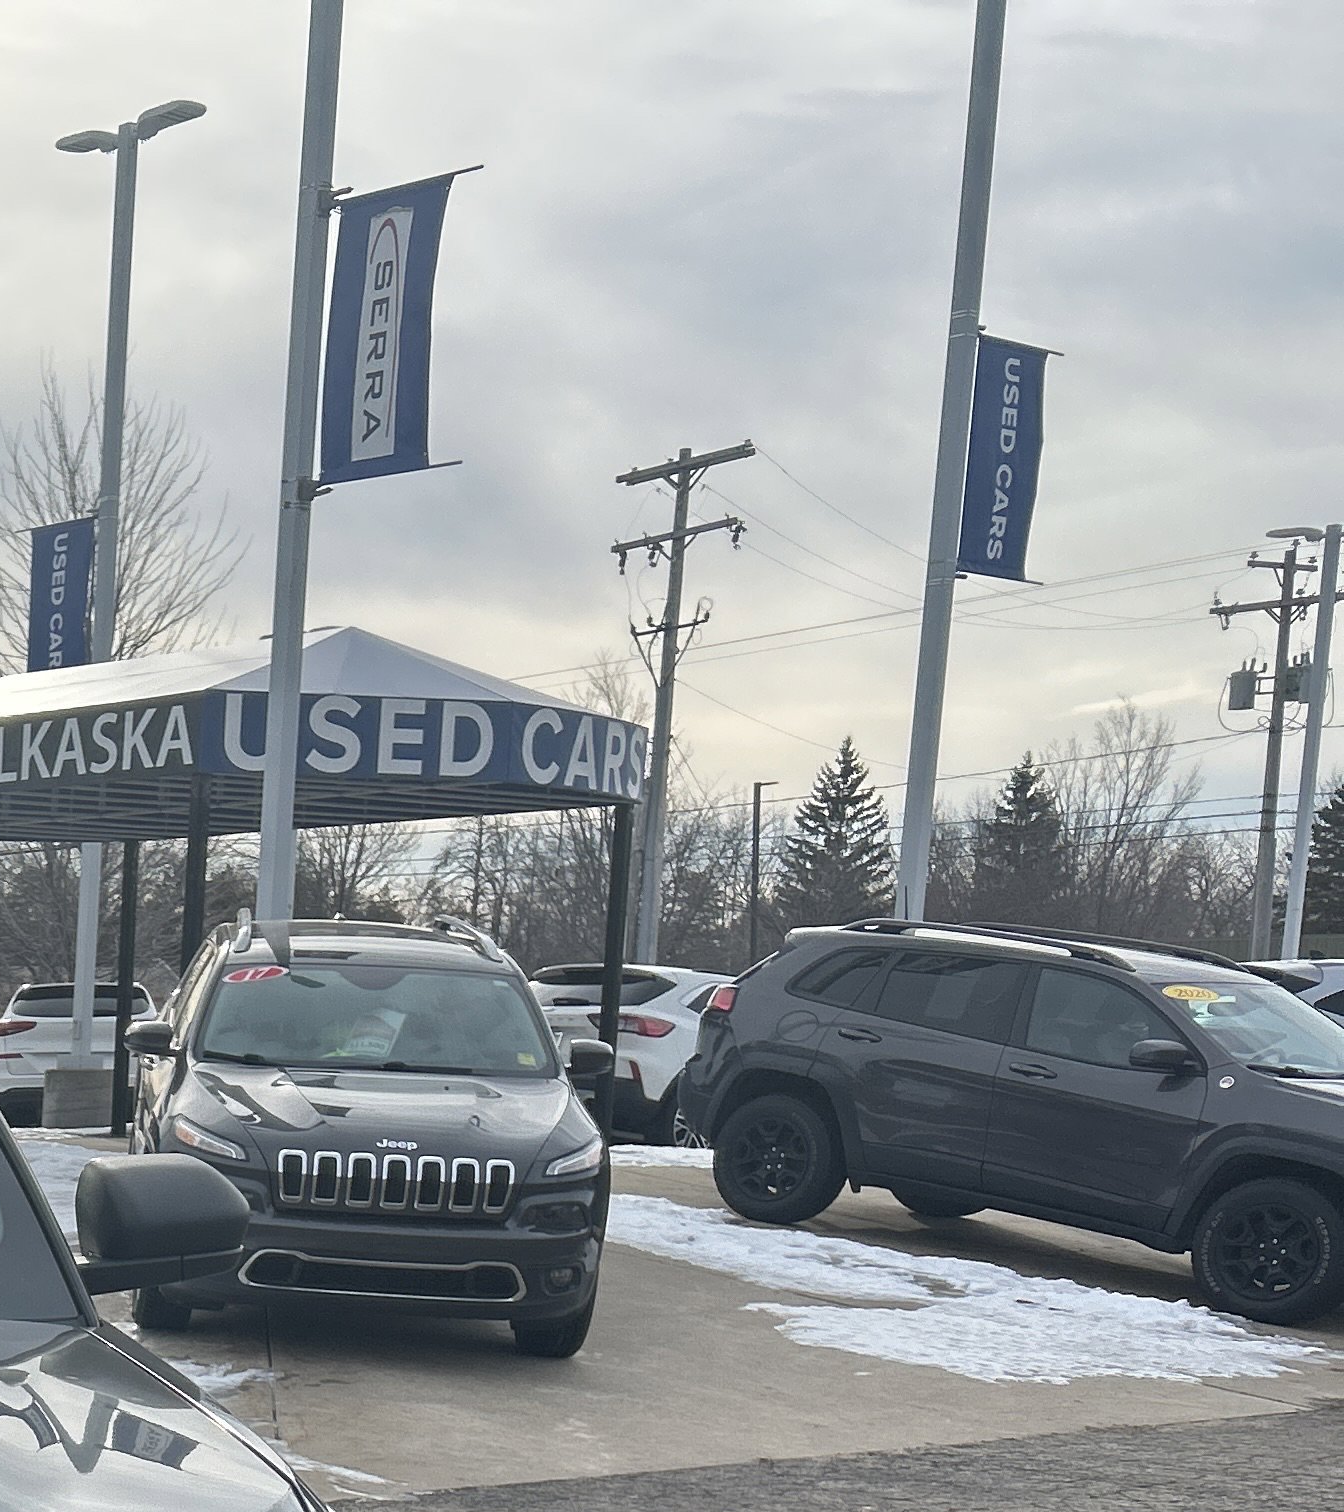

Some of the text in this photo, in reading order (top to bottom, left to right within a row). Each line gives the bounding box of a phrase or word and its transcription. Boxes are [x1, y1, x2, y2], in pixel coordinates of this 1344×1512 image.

[361, 260, 394, 443] SERRA
[986, 357, 1021, 560] USED CARS
[49, 532, 69, 668] USED CAR
[223, 692, 647, 800] USED CARS
[1174, 988, 1212, 999] 2020
[375, 1138, 418, 1151] Jeep
